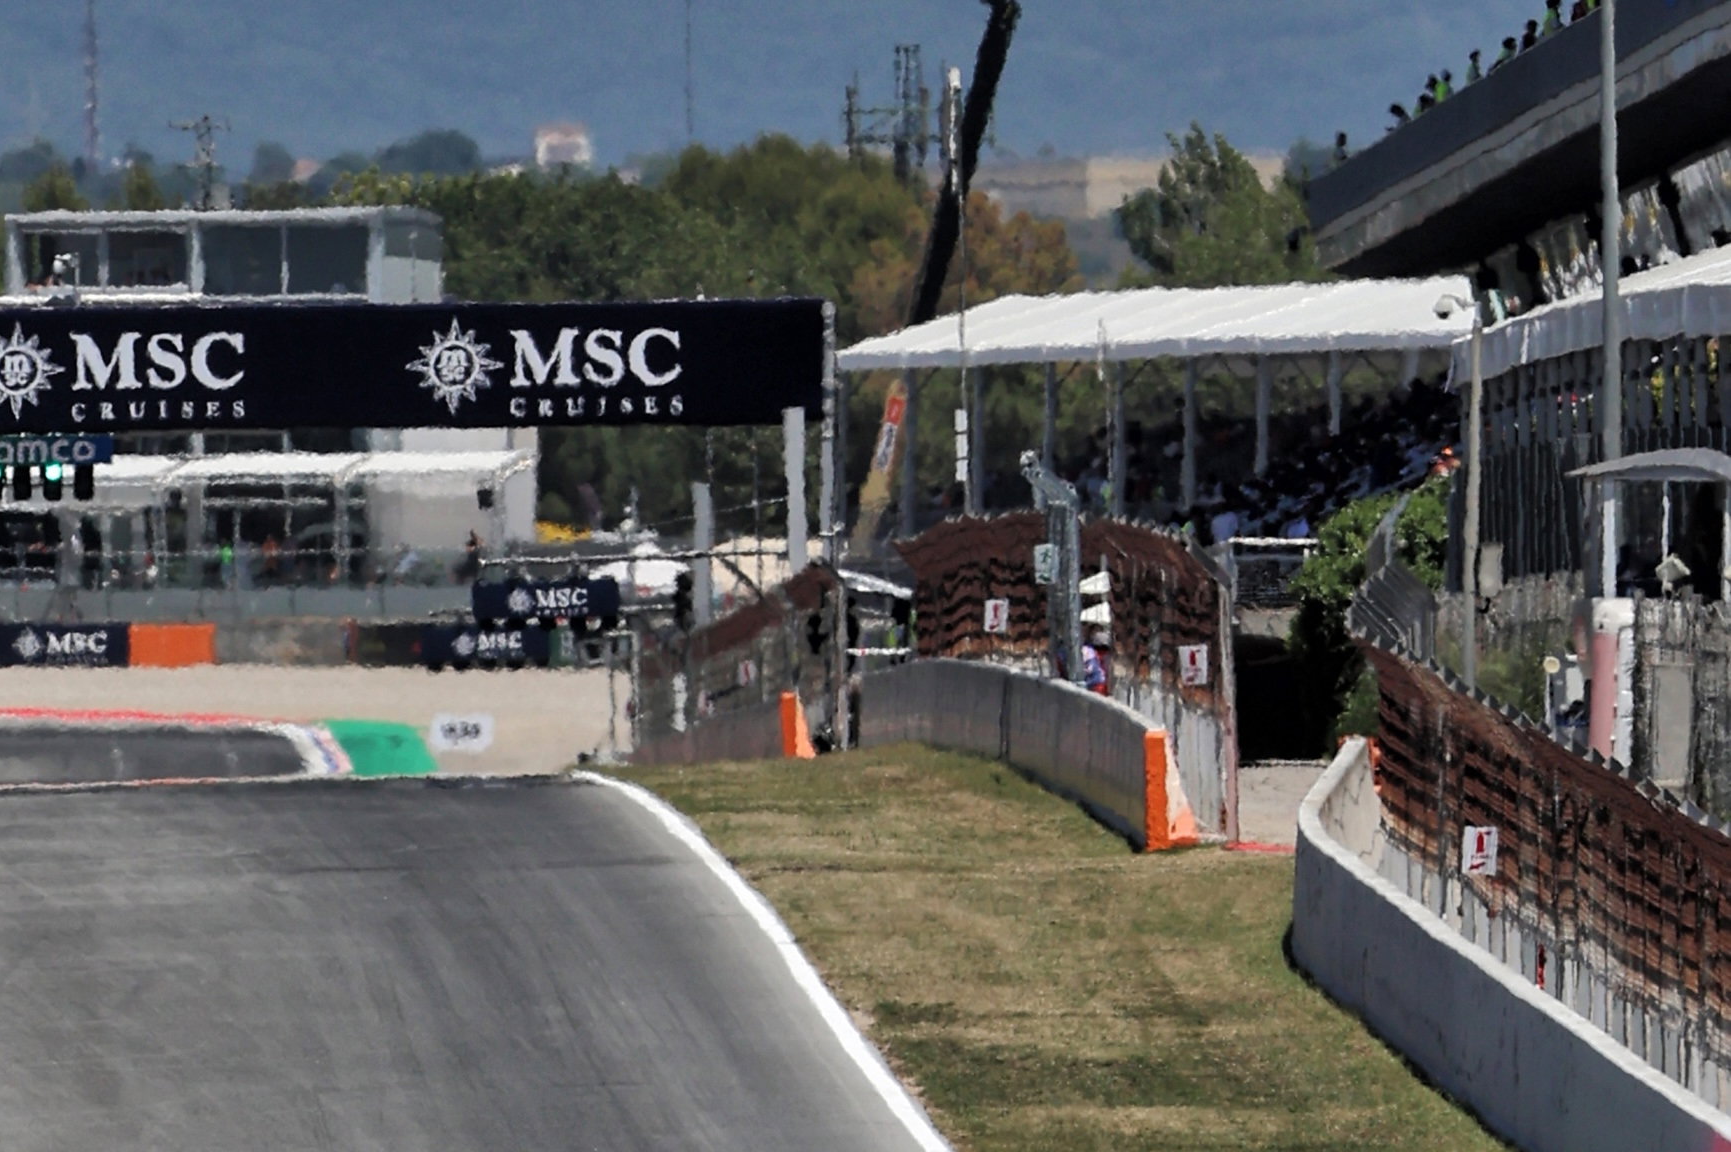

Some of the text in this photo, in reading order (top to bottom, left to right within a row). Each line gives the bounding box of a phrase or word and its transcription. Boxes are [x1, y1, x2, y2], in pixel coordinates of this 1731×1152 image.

[69, 331, 245, 390] MSC
[510, 327, 683, 387] MSC
[71, 400, 245, 422] CRUISES
[509, 395, 684, 417] CRUISES
[535, 587, 588, 608] MSC
